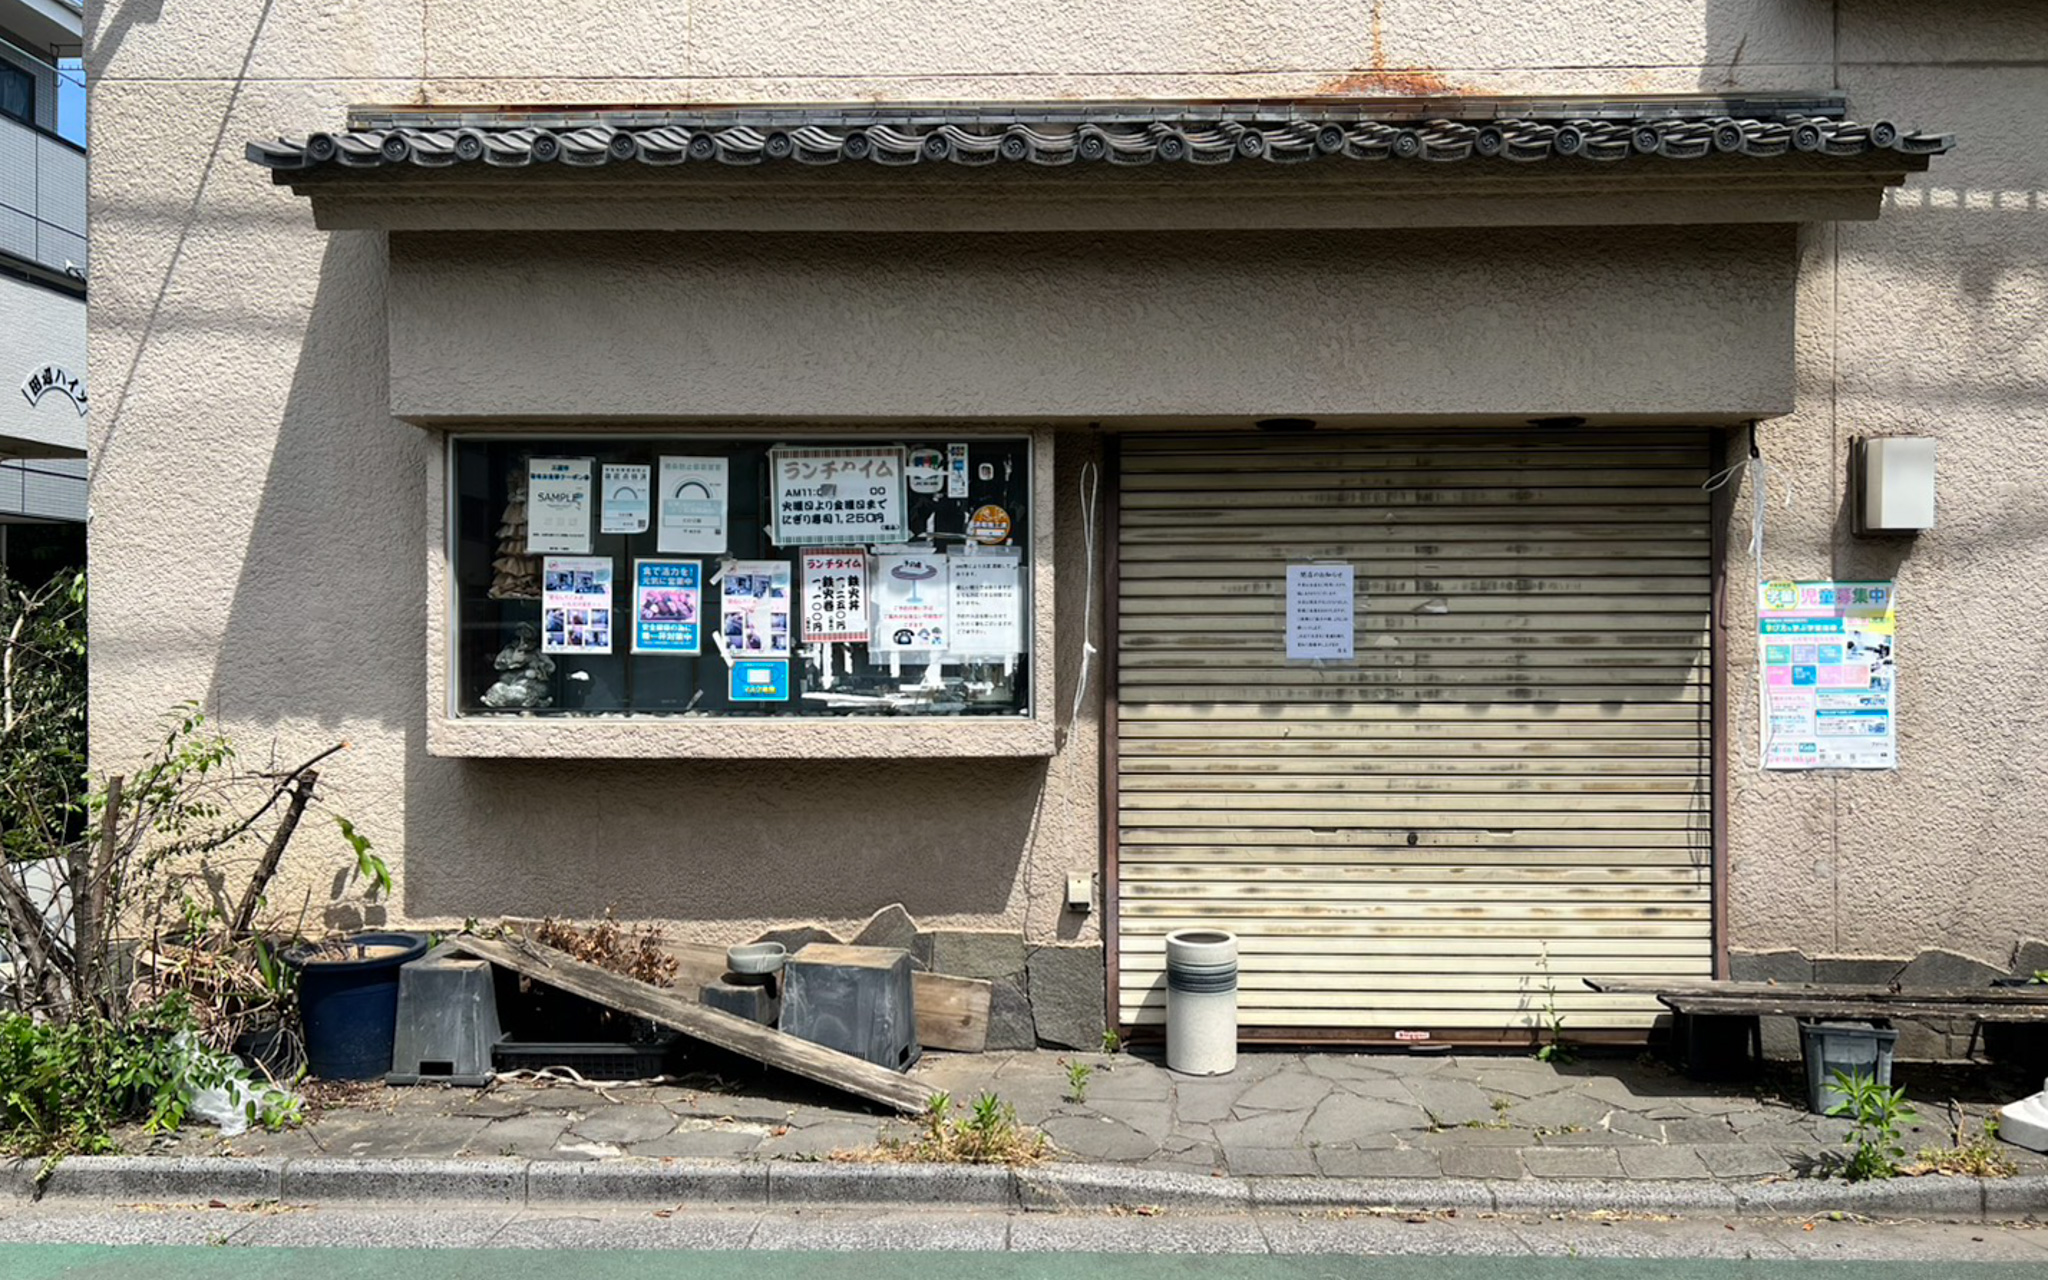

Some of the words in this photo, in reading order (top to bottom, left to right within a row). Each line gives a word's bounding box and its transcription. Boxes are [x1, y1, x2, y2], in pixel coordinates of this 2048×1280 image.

[537, 491, 579, 503] SAMPLE
[782, 498, 888, 511] 火曜日より金曜日まで
[807, 558, 862, 569] ランチタイム
[642, 577, 694, 585] 元気に営業中
